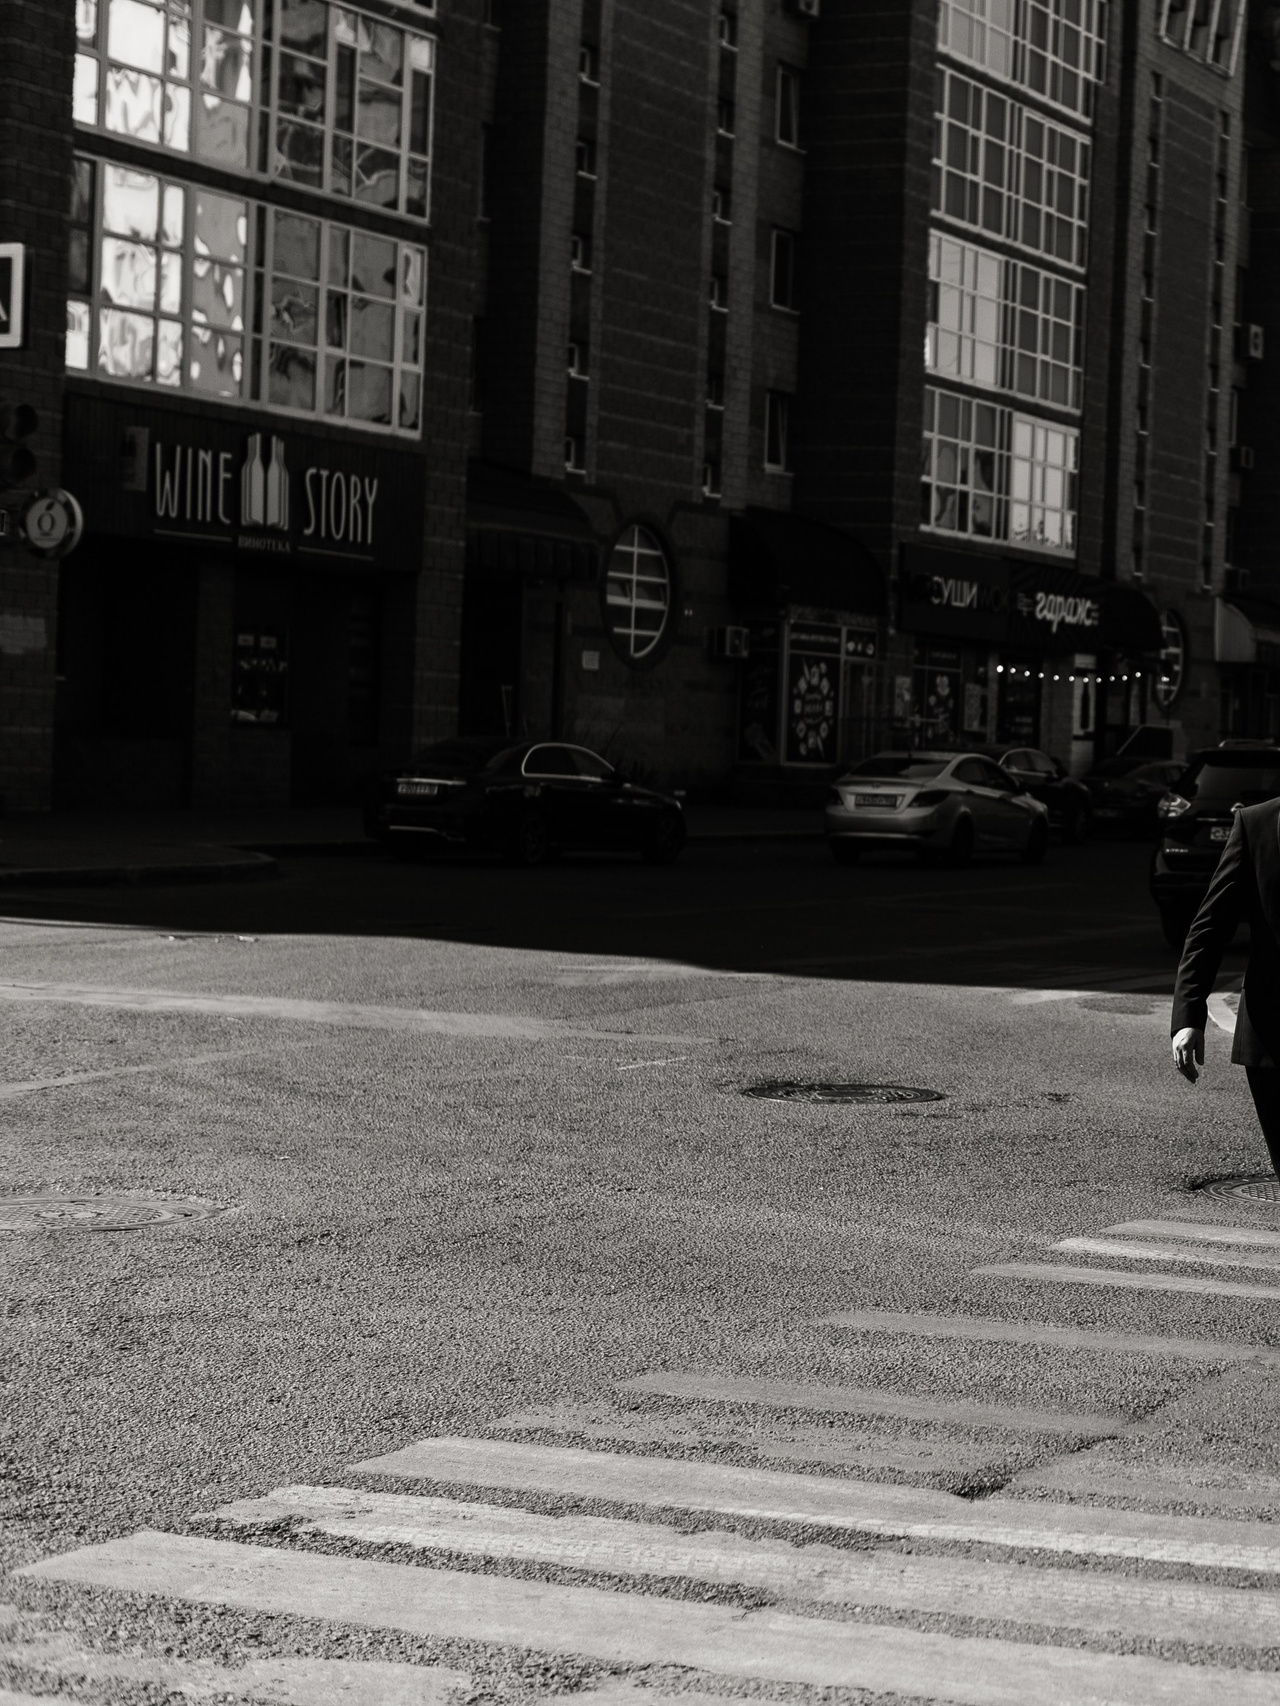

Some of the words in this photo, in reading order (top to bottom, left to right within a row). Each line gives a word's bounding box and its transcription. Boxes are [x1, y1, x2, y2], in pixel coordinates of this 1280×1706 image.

[154, 441, 234, 525] WINE
[301, 466, 379, 546] STORY
[237, 535, 291, 553] ВИНОТЕКА
[930, 575, 979, 609] СУШИ
